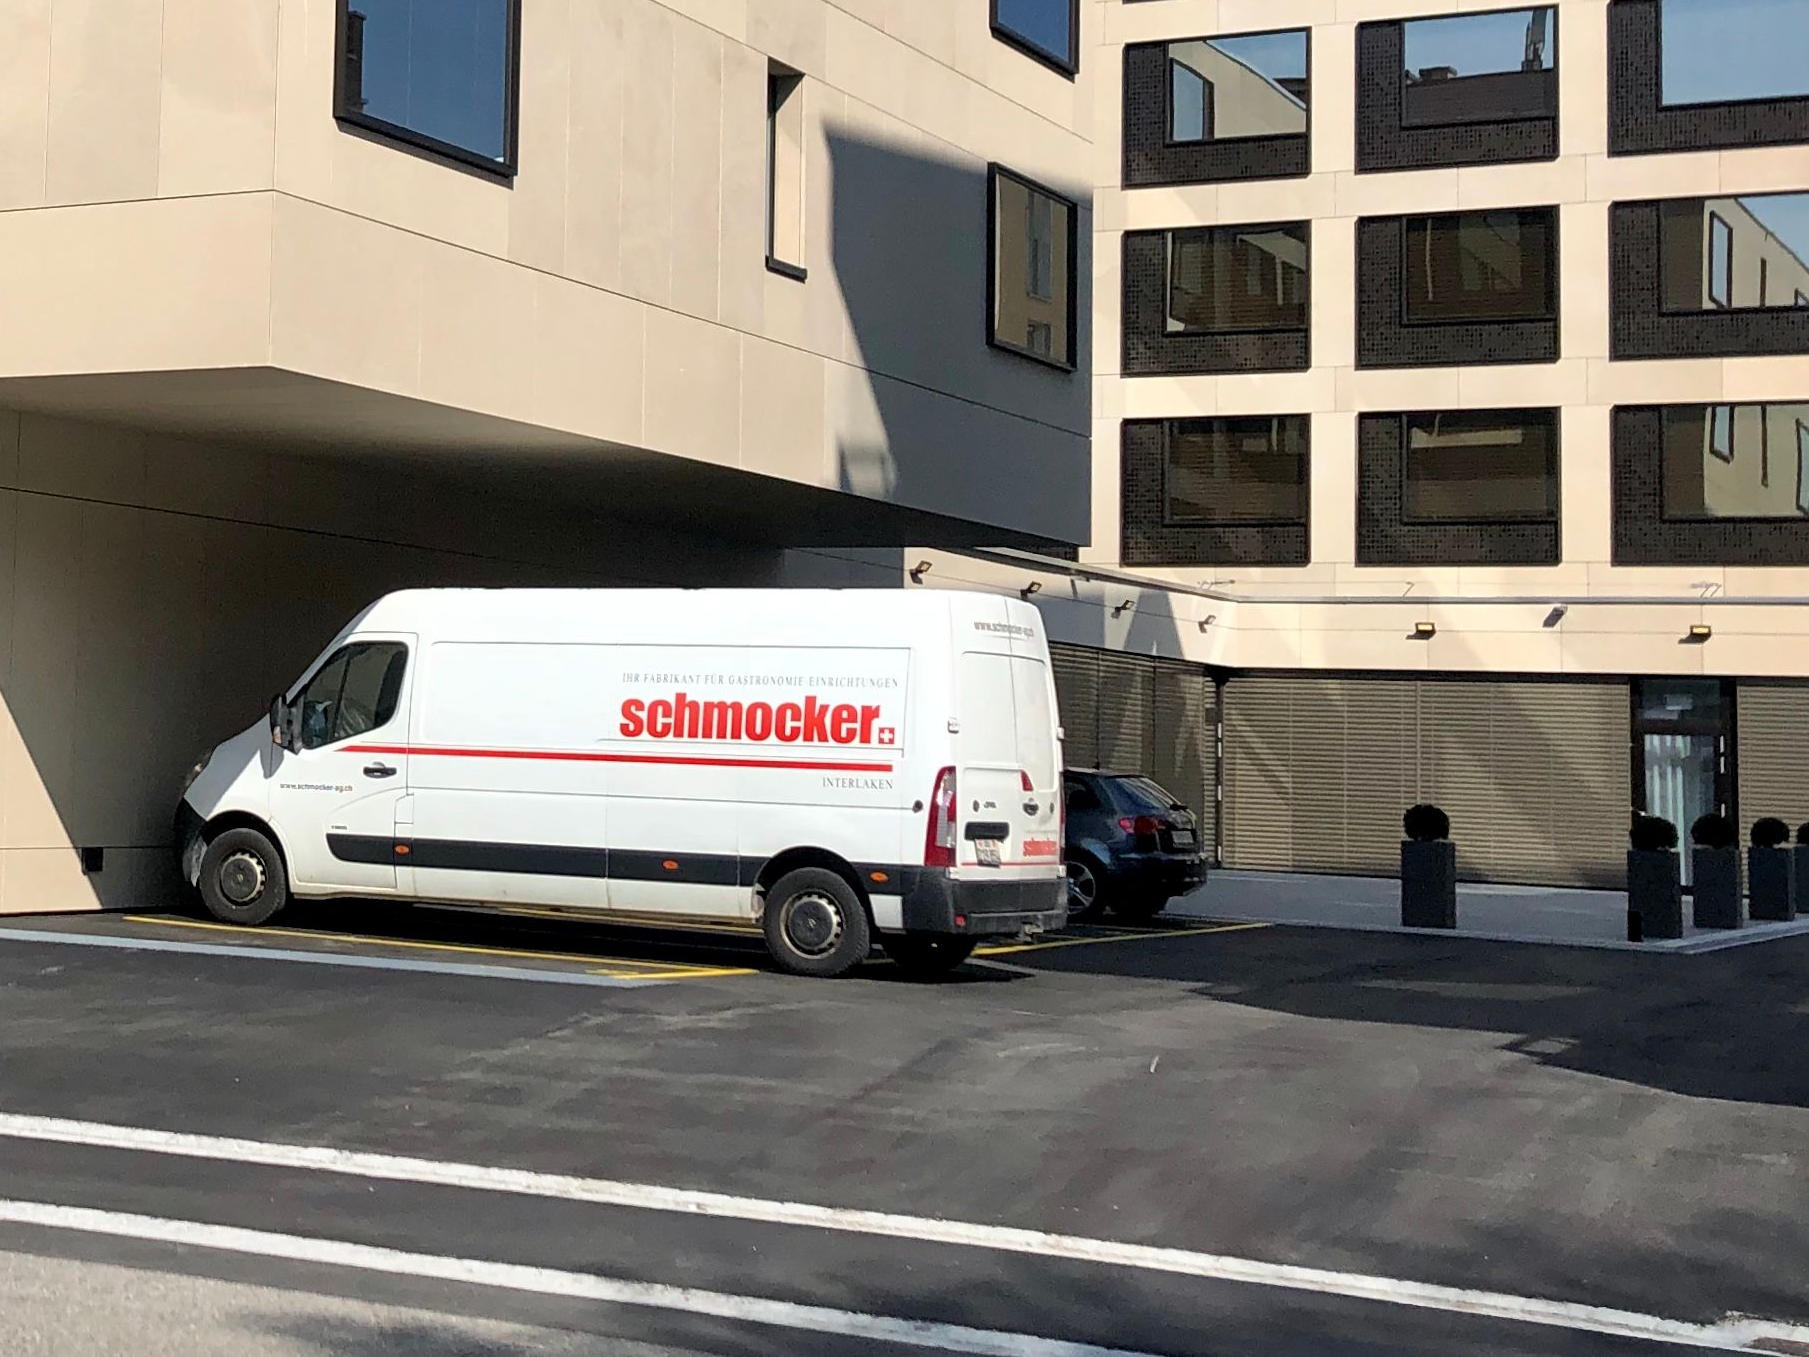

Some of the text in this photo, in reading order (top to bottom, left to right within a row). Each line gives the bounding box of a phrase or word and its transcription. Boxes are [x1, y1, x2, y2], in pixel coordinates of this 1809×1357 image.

[622, 672, 898, 688] IHR FABRIKANT FÜR GASTRONOMIE EINRICHTUNGEN
[619, 692, 880, 744] schmocker
[822, 776, 893, 790] INTERLAKEN
